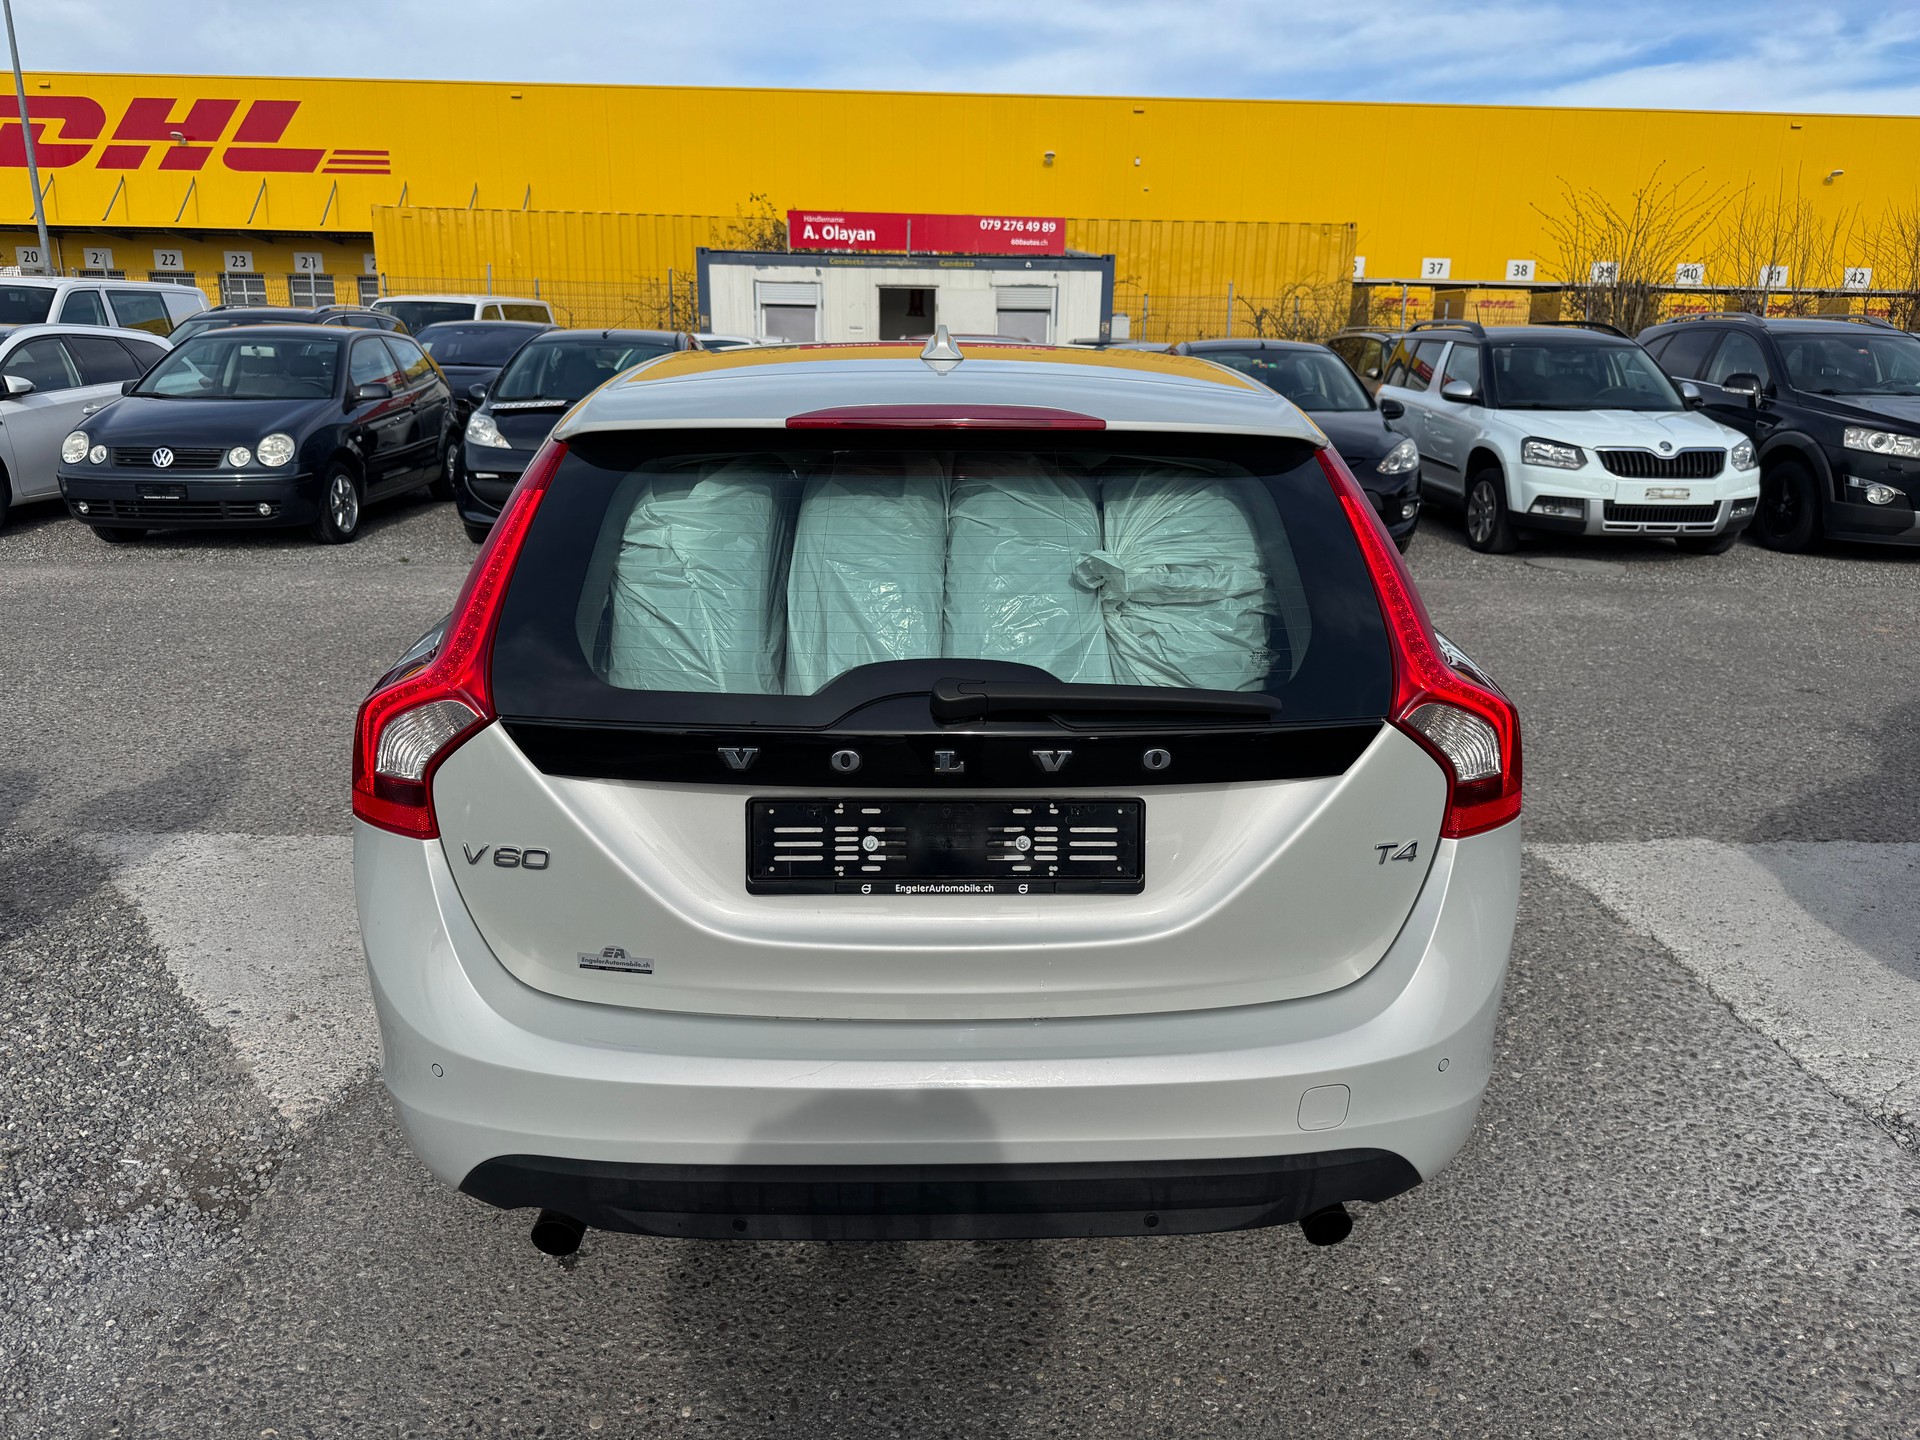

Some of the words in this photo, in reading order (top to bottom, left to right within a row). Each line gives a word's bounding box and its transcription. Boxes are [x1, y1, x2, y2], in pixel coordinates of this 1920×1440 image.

[0, 94, 327, 173] DHL
[980, 219, 1001, 231] 079
[1003, 220, 1025, 232] 276
[1026, 221, 1041, 233] 49
[1042, 222, 1057, 233] 89
[803, 224, 820, 240] A.
[822, 225, 876, 244] Olayan
[23, 250, 39, 263] 20
[161, 253, 177, 266] 22
[231, 255, 247, 268] 23
[1428, 262, 1444, 275] 37
[1512, 264, 1528, 277] 38
[1682, 267, 1698, 280] 40
[1850, 272, 1865, 284] 42
[718, 747, 1171, 773] VOLVO
[1374, 840, 1418, 865] T4
[895, 884, 995, 894] EngelerAutomobile.ch
[602, 947, 626, 959] EA
[581, 957, 651, 968] EngelerAutomobile.ch
